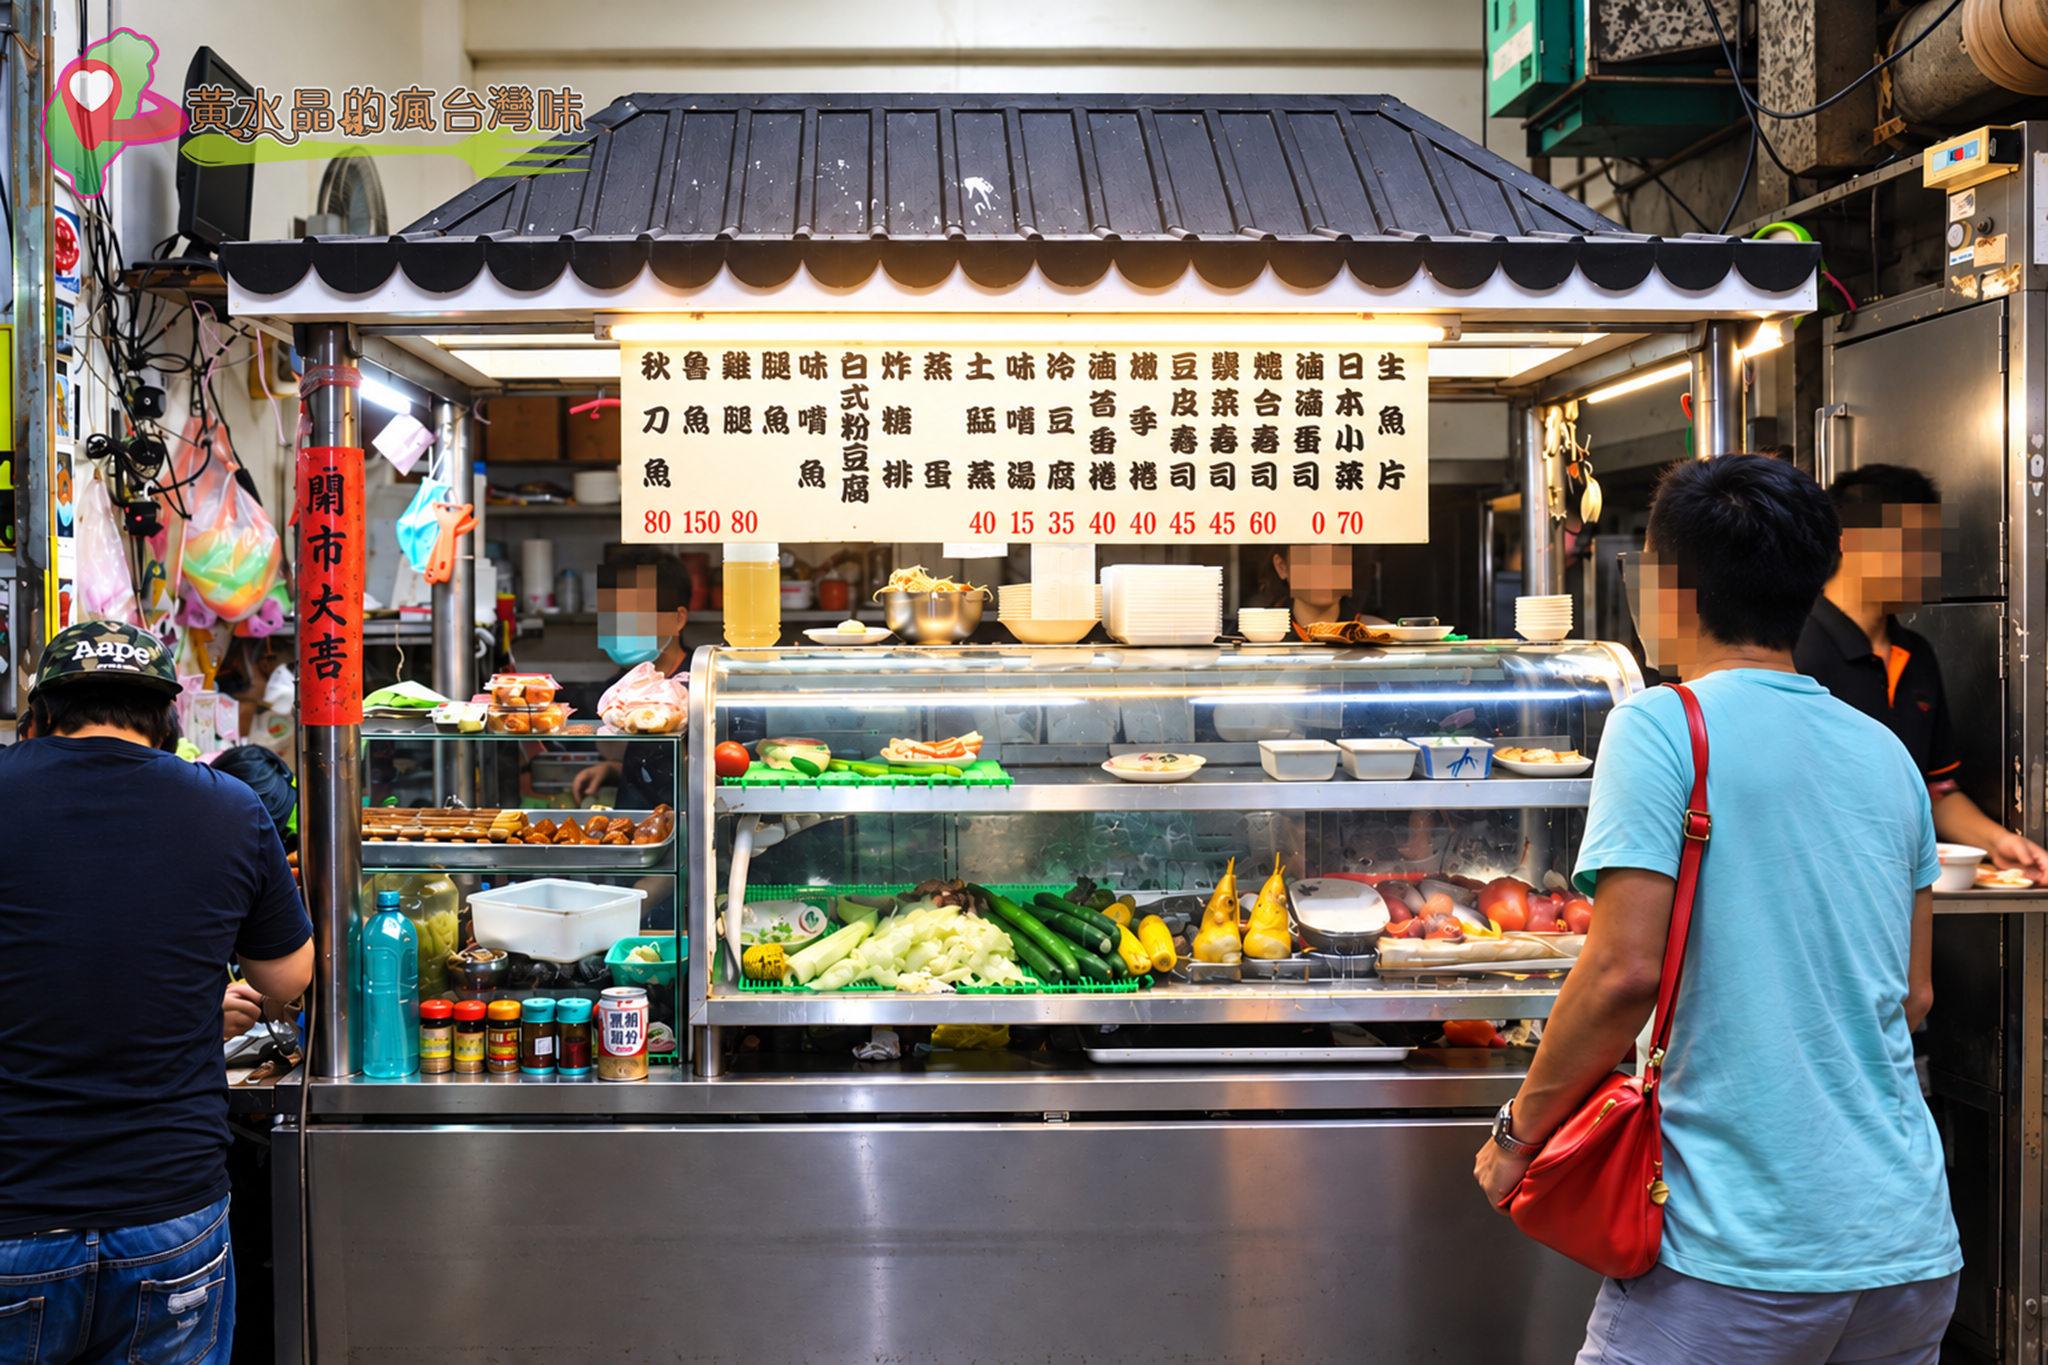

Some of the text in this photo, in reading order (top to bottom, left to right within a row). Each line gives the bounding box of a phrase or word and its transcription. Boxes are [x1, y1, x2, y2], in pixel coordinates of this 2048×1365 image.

[642, 351, 671, 489] 秋刀魚
[1047, 351, 1076, 491] 冷豆腐
[1378, 351, 1406, 491] 生魚片
[644, 510, 1363, 534] 80 150 80 40 15 35 40 40 45 45 60 0 70
[72, 640, 150, 665] Aape
